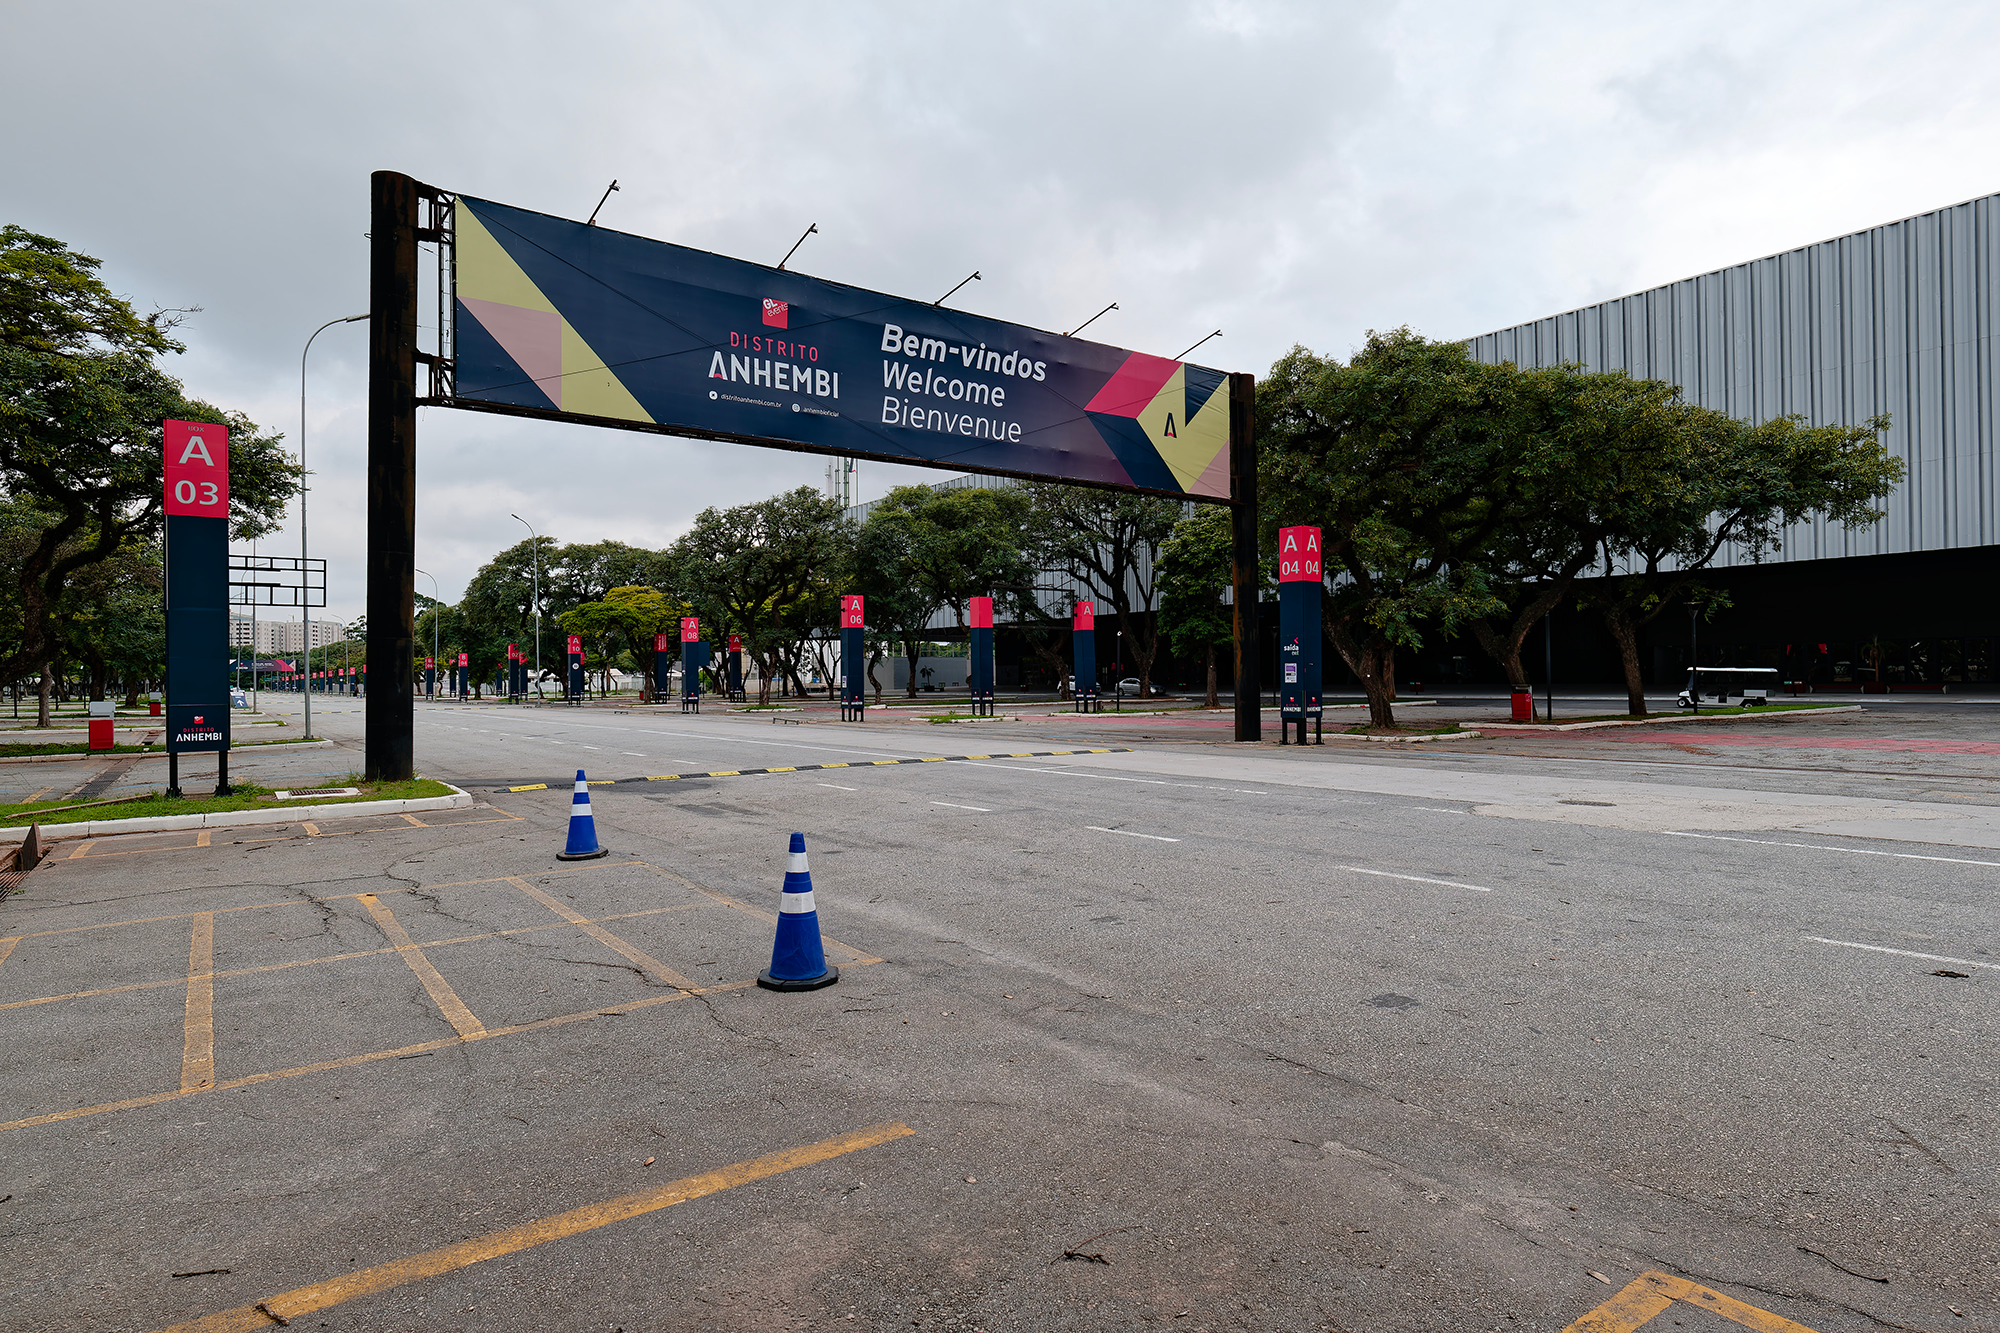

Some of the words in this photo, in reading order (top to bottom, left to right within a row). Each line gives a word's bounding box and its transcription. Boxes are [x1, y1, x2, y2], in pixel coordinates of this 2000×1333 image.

[763, 298, 778, 310] GL
[767, 303, 788, 317] events
[730, 331, 819, 362] DISTRITO
[880, 323, 1048, 382] Bem-vindos
[708, 350, 839, 399] ANHEMBI
[883, 359, 1006, 408] Welcome
[720, 393, 782, 408] distritoanhembi.com.br
[881, 396, 1022, 443] Bienvenue
[187, 425, 205, 433] BOX
[178, 435, 215, 467] A
[175, 480, 219, 506] 03
[1283, 534, 1298, 553] A
[1306, 534, 1318, 553] A
[1281, 560, 1300, 576] 04
[1305, 560, 1320, 575] 04
[851, 599, 861, 611] A
[1083, 605, 1092, 616] A
[688, 620, 697, 629] A
[850, 614, 862, 624] 06
[687, 631, 698, 640] 08
[176, 732, 222, 742] ANHEMBI
